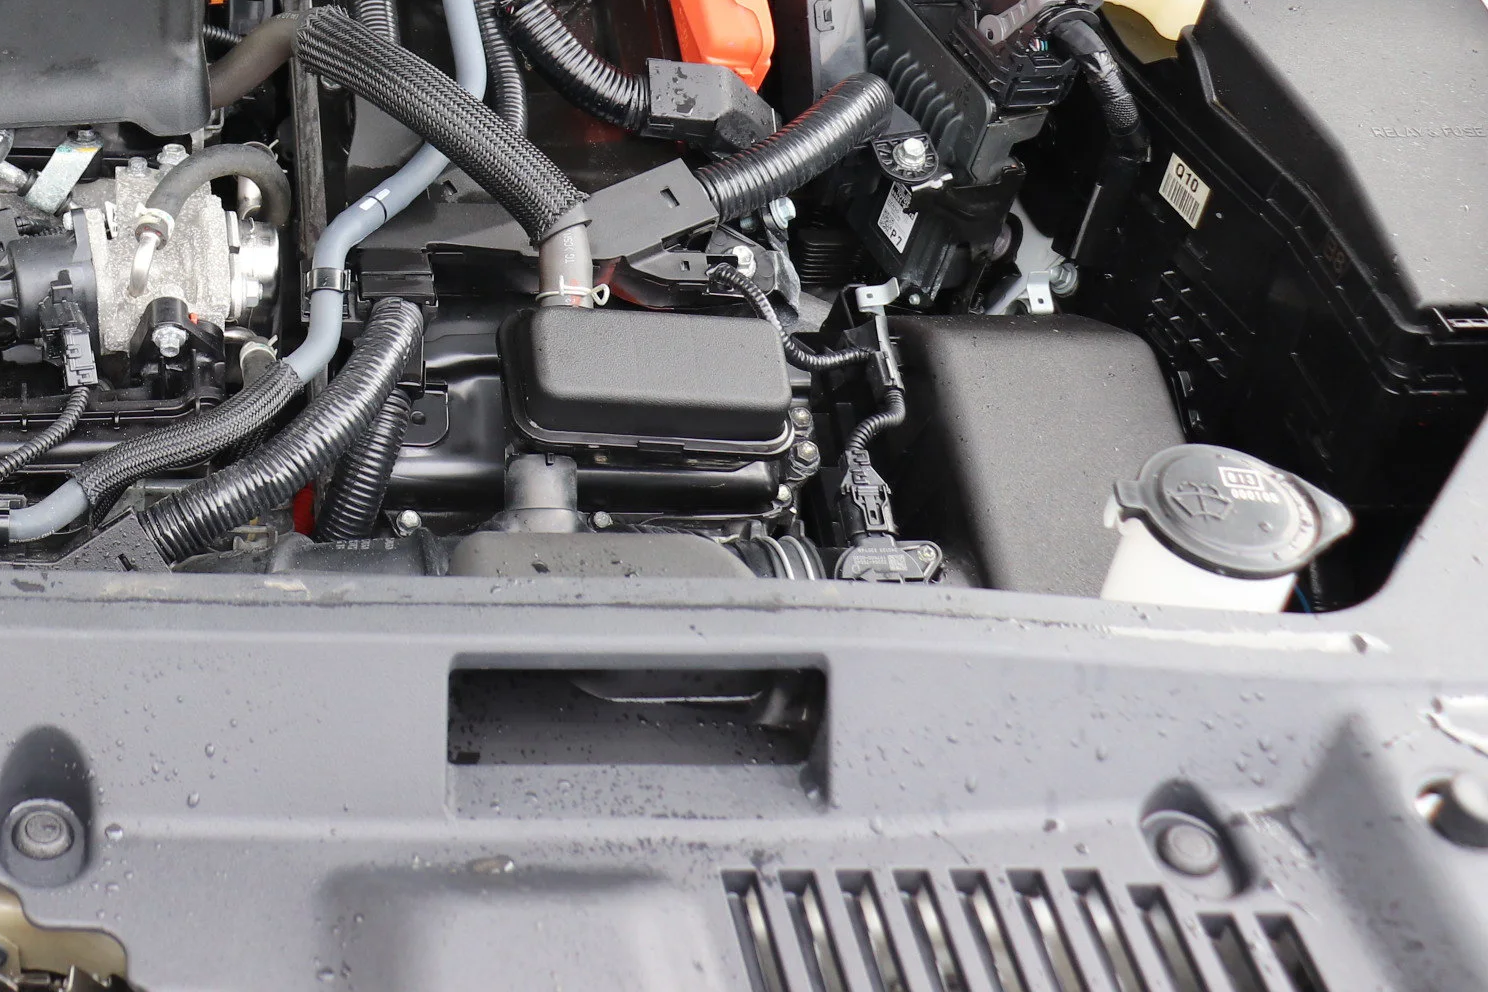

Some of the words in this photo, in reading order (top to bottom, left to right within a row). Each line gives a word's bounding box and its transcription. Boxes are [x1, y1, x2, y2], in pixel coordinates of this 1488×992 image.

[1371, 127, 1422, 138] RELAY
[1441, 127, 1488, 138] FUSE
[1175, 162, 1199, 193] Q10
